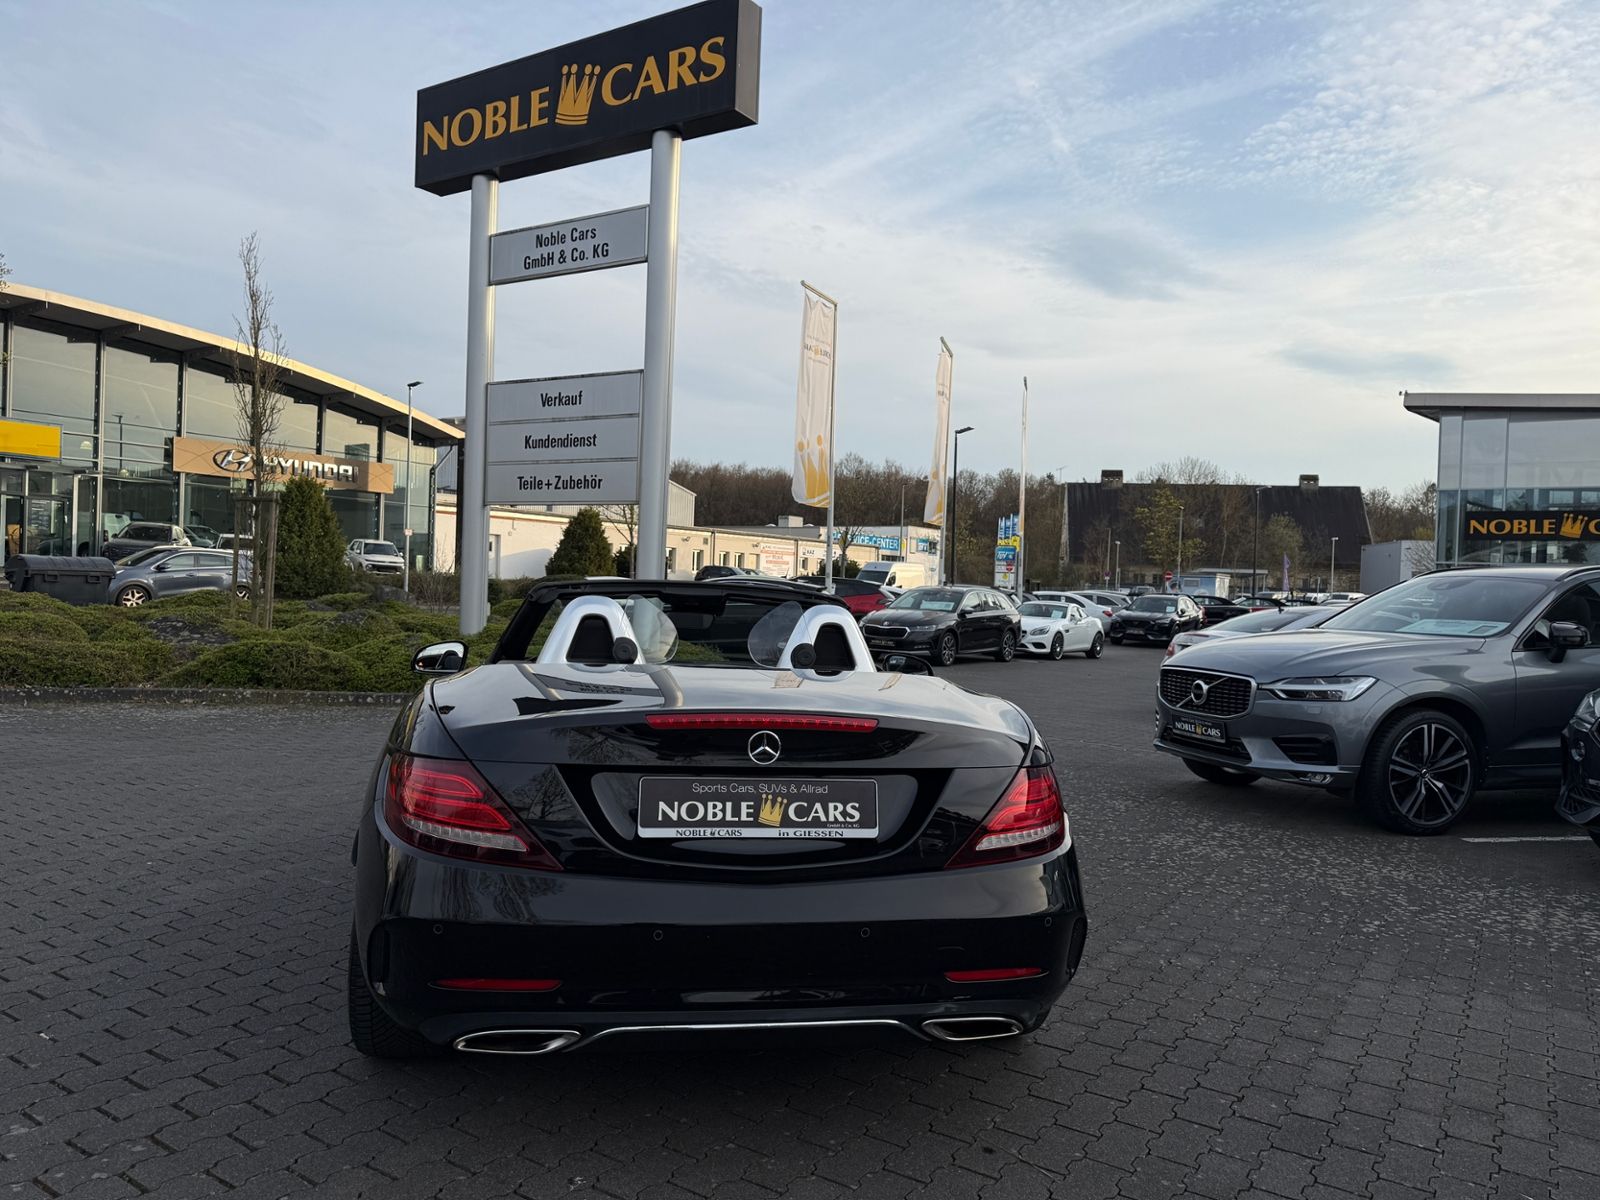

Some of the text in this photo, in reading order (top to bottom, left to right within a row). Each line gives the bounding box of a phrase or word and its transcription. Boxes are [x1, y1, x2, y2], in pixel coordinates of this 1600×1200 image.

[423, 36, 726, 156] NOBLE CARS
[535, 227, 597, 248] Noble Cars
[523, 242, 609, 270] GmbH & Co. KG
[540, 390, 583, 408] Verkauf
[524, 433, 597, 449] Kundendienst
[263, 456, 359, 483] HYUNDAI
[517, 474, 603, 490] Teile+Zubehör
[1469, 519, 1556, 535] NOBLE
[1175, 721, 1221, 737] NOBLE CARS
[692, 782, 829, 794] Sports Cars, SUVs & Allrad
[658, 801, 861, 822] NOBLE CARS
[675, 829, 743, 837] NOBLE CARS
[778, 829, 844, 837] in GIESSEN
